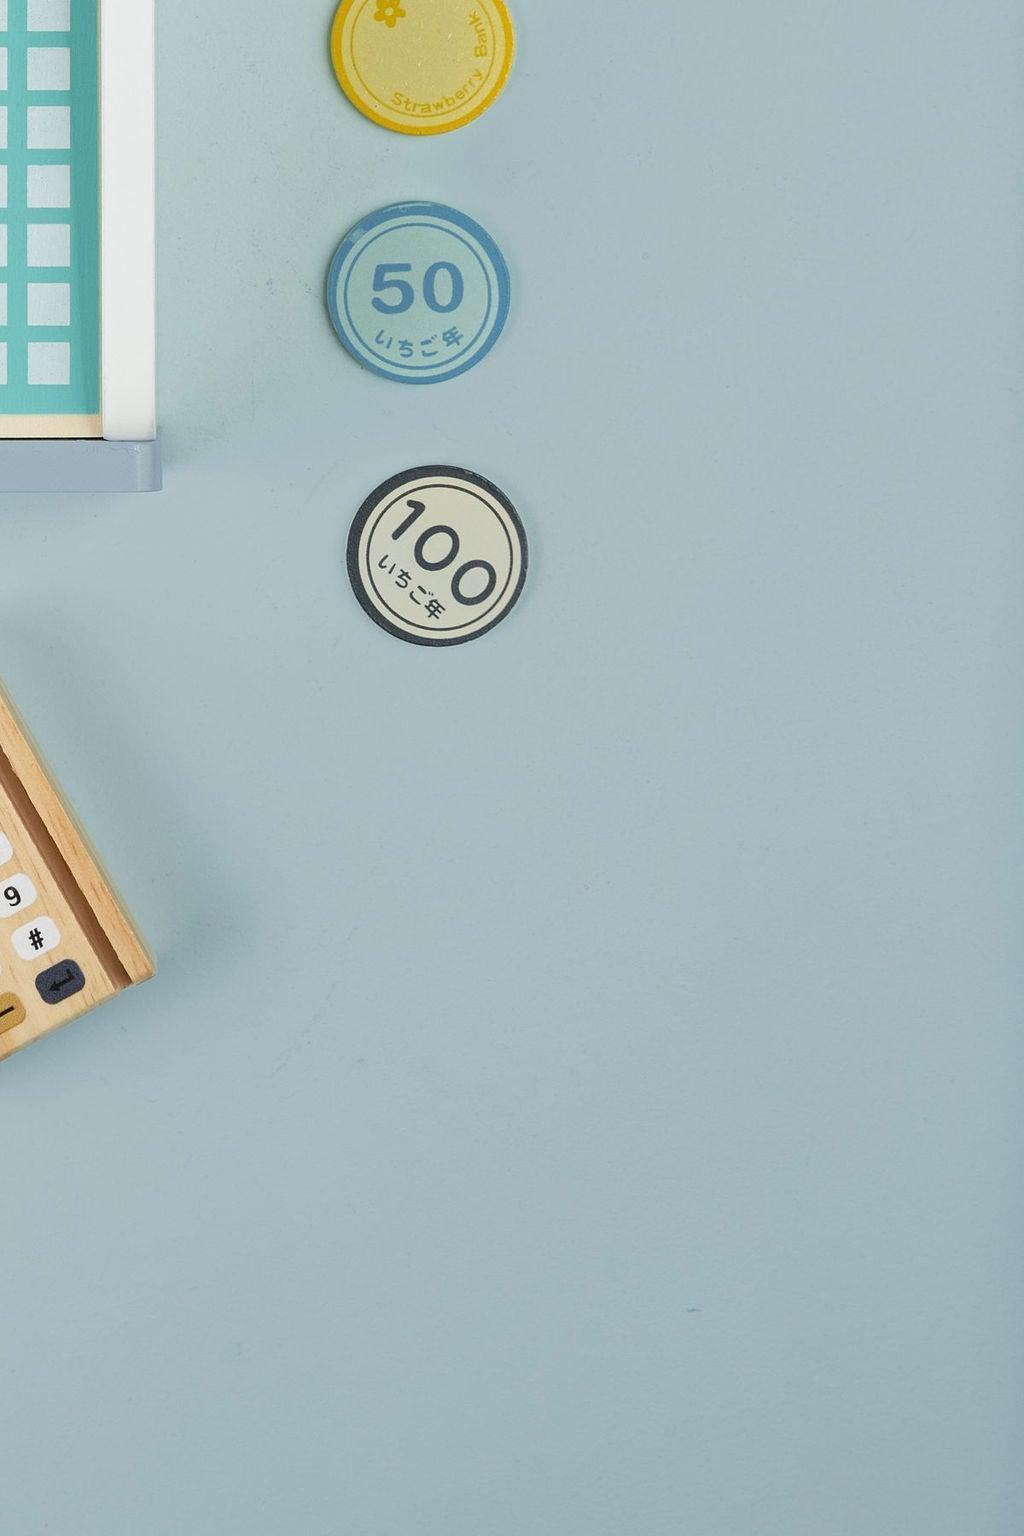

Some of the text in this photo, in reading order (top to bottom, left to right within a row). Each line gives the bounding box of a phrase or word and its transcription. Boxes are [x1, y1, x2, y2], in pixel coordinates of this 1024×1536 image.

[391, 10, 487, 114] Strawberry Bank
[371, 261, 464, 314] 50
[374, 326, 464, 358] いちご年
[392, 499, 497, 607] 100
[378, 554, 446, 620] いちご年
[3, 886, 22, 907] 9
